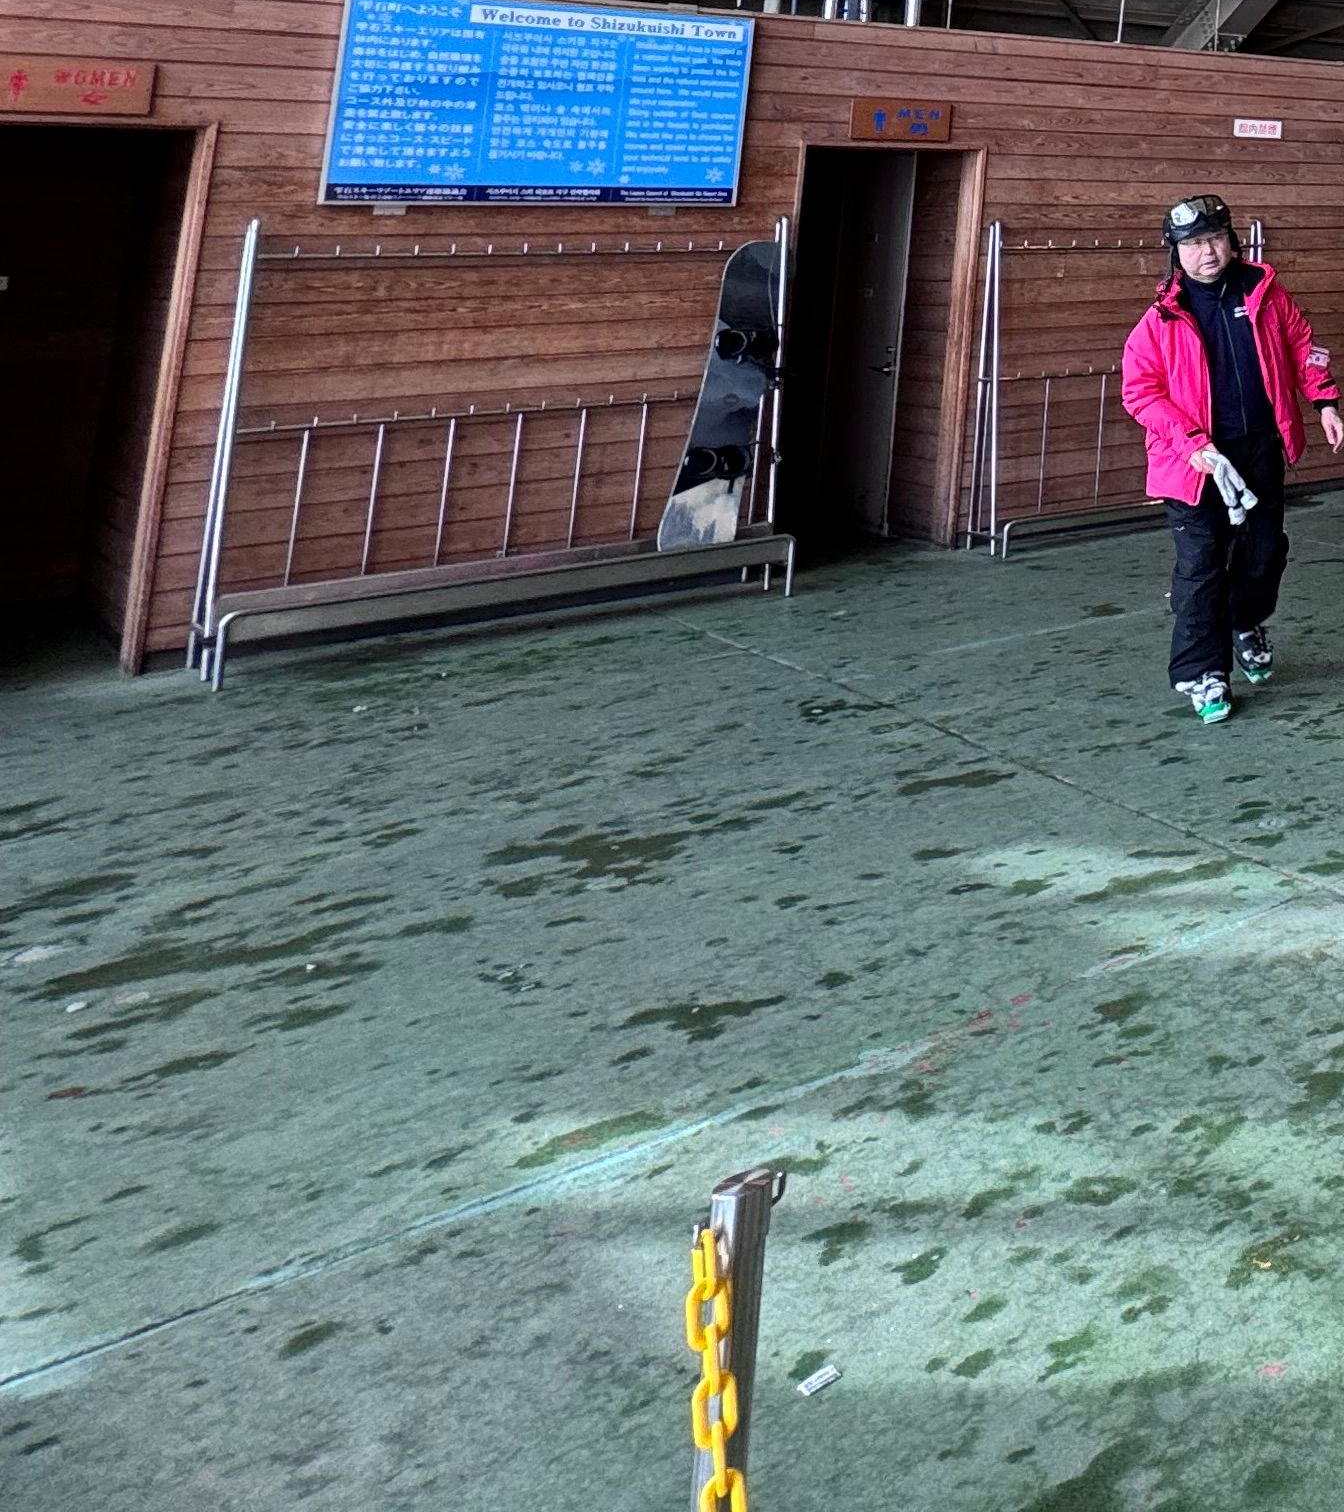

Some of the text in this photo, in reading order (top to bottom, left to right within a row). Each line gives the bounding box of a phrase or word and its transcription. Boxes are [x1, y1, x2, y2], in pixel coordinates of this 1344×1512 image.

[480, 8, 737, 39] Welcome to Shizukuishi Town
[54, 68, 137, 88] WOMEN
[896, 107, 941, 121] MEN
